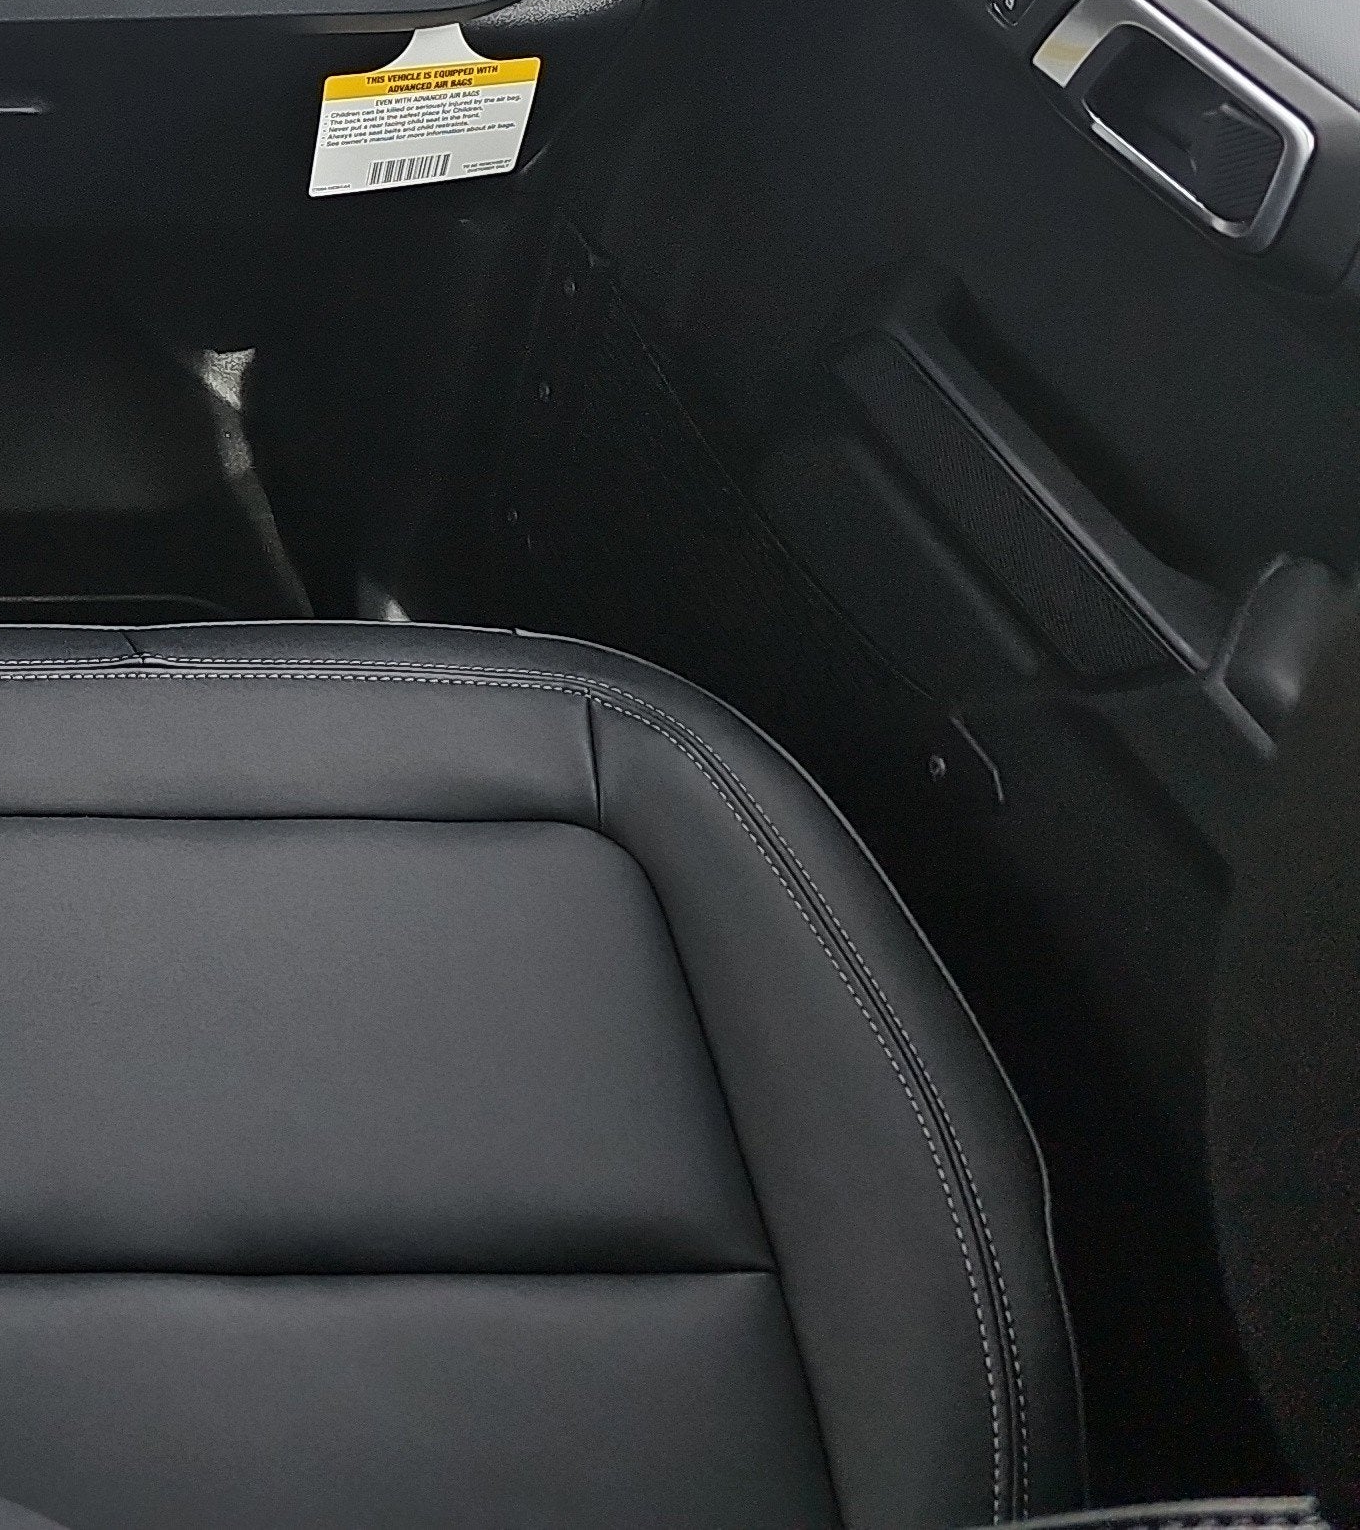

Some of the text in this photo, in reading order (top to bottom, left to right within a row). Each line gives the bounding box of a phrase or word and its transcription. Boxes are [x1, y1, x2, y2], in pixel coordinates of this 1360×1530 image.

[366, 65, 498, 85] THIS VEHICLE IS EQUIPPED WITH
[387, 78, 473, 93] ADVANCED AIR BAGS
[375, 98, 393, 106] EVEN
[413, 92, 448, 102] ADVANCED
[449, 91, 460, 99] AIR
